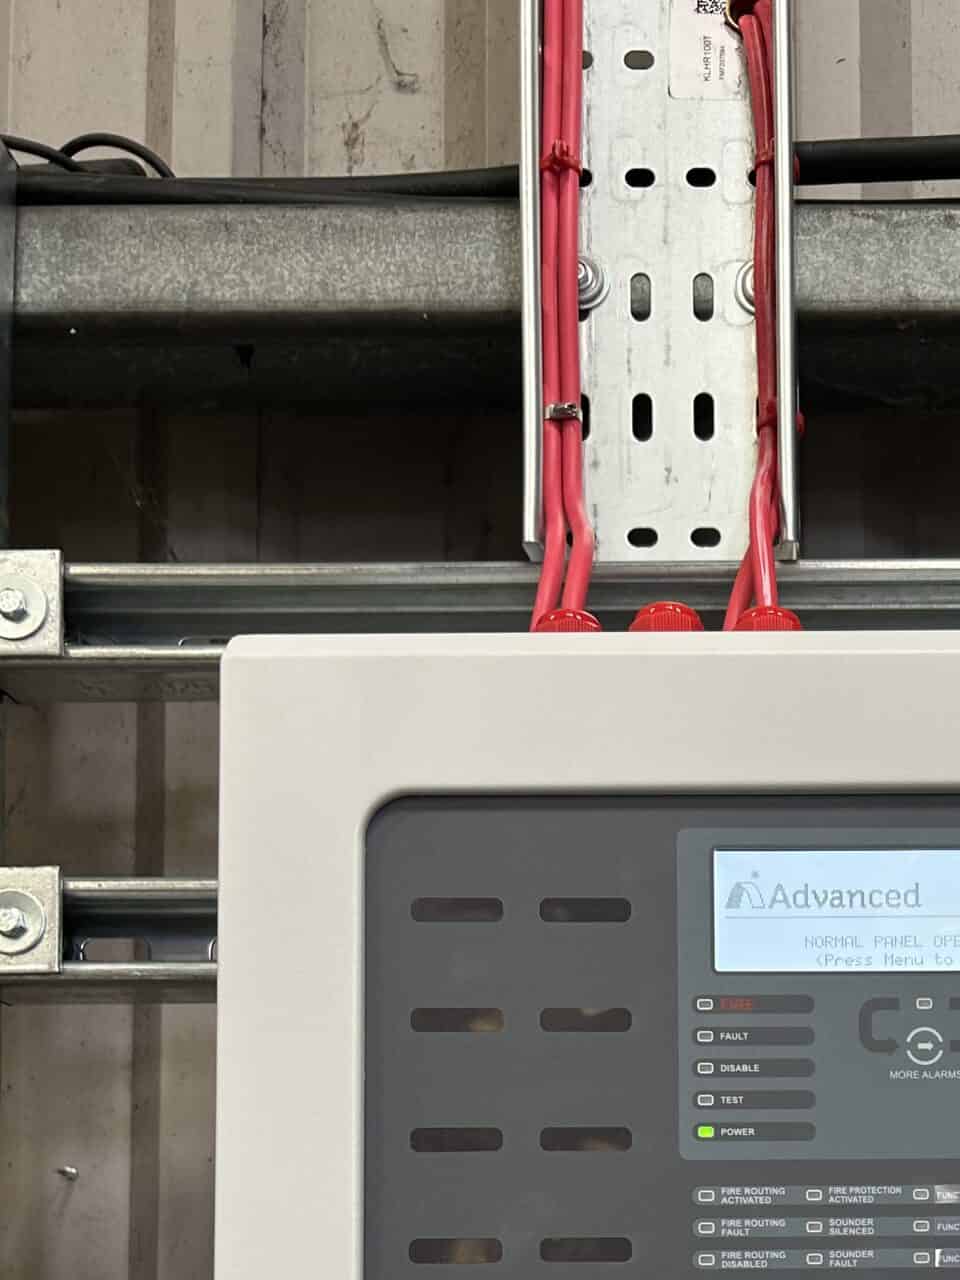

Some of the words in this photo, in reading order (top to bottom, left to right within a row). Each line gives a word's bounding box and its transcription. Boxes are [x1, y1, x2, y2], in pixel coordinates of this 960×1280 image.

[768, 881, 923, 910] Advanced
[804, 935, 864, 949] NORMAL
[874, 935, 923, 949] PANEL
[815, 952, 873, 967] (Press
[884, 953, 924, 967] Menu
[934, 953, 954, 967] to
[720, 1031, 749, 1042] FAULT
[720, 1063, 760, 1073] DISABLE
[889, 1069, 920, 1080] MORE
[720, 1095, 744, 1105] TEST
[720, 1127, 756, 1137] POWER
[721, 1187, 743, 1196] FIRE
[744, 1187, 786, 1196] ROUTING
[850, 1185, 903, 1195] PROTECTION
[720, 1195, 772, 1205] ACTIVATED
[828, 1195, 875, 1204] ACTIVATED
[721, 1219, 743, 1228] FIRE
[744, 1218, 786, 1228] ROUTING
[828, 1218, 875, 1227] SOUNDER
[721, 1228, 750, 1237] FAULT
[828, 1227, 875, 1236] SILENCED
[721, 1251, 743, 1260] FIRE
[744, 1250, 787, 1260] ROUTING
[828, 1250, 875, 1259] SOUNDER
[721, 1260, 768, 1269] DISABLED
[828, 1259, 858, 1268] FAULT
